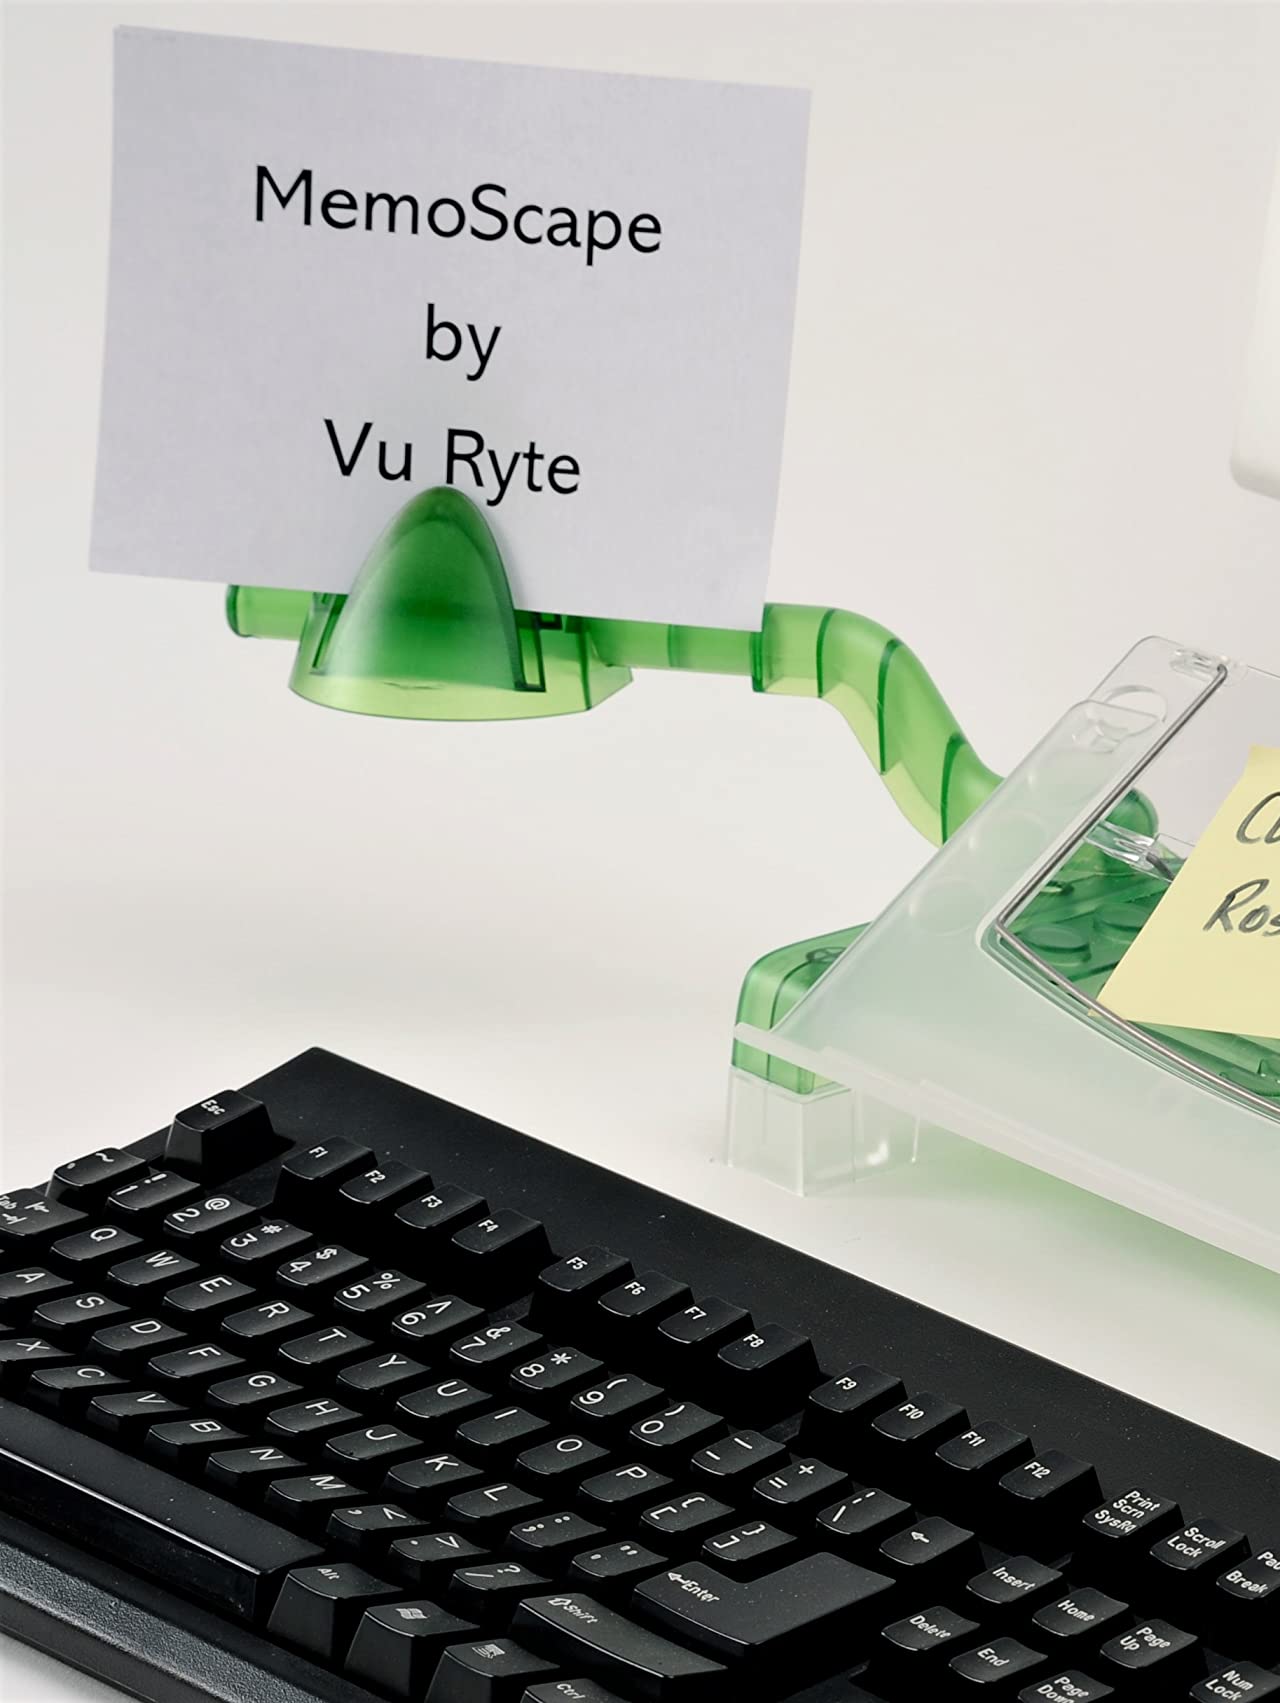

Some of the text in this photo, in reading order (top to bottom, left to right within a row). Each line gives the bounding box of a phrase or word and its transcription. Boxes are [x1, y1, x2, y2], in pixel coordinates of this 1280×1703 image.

[253, 164, 664, 267] MemoScape
[423, 302, 503, 382] by
[322, 417, 582, 507] Vu Ryte
[200, 1099, 225, 1115] Esc
[92, 1148, 114, 1163] ~
[309, 1146, 329, 1158] F1
[144, 1173, 167, 1184] !
[364, 1169, 386, 1184] F2
[116, 1185, 139, 1196] 1
[204, 1197, 231, 1211] @
[421, 1195, 443, 1208] F3
[172, 1208, 201, 1222] 2
[260, 1224, 283, 1234] #
[478, 1219, 499, 1233] F4
[90, 1228, 118, 1242] Q
[230, 1233, 258, 1248] 3
[145, 1251, 180, 1268] W
[315, 1248, 338, 1260] $
[289, 1261, 312, 1273] 4
[566, 1256, 588, 1270] F5
[15, 1272, 46, 1284] A
[199, 1276, 233, 1293] E
[372, 1272, 401, 1290] %
[342, 1284, 371, 1299] 5
[624, 1281, 646, 1295] F6
[75, 1296, 105, 1309] S
[258, 1302, 290, 1319] R
[684, 1306, 707, 1320] F7
[401, 1311, 427, 1325] 6
[130, 1320, 162, 1334] D
[486, 1326, 512, 1340] &
[318, 1328, 347, 1342] T
[743, 1333, 765, 1348] F8
[16, 1341, 50, 1352] X
[461, 1336, 487, 1350] 7
[188, 1346, 221, 1357] F
[378, 1354, 407, 1368] Y
[77, 1367, 105, 1379] C
[519, 1363, 545, 1378] 8
[248, 1374, 276, 1387] G
[606, 1378, 628, 1390] (
[835, 1377, 857, 1390] F9
[437, 1381, 468, 1397] U
[136, 1393, 166, 1403] V
[579, 1390, 605, 1405] 9
[305, 1400, 339, 1416] H
[494, 1409, 518, 1420] I
[664, 1404, 685, 1417] )
[898, 1403, 924, 1420] F10
[189, 1421, 222, 1433] B
[365, 1429, 397, 1441] J
[961, 1431, 986, 1447] F11
[556, 1438, 583, 1452] O
[249, 1448, 284, 1461] N
[424, 1455, 459, 1472] K
[798, 1465, 815, 1475] +
[1024, 1461, 1051, 1479] F12
[615, 1466, 648, 1479] P
[309, 1475, 346, 1490] M
[768, 1476, 788, 1489] =
[483, 1485, 508, 1502] L
[681, 1496, 706, 1509] {
[1112, 1498, 1145, 1519] Scrn
[1125, 1490, 1161, 1513] Print
[382, 1507, 407, 1520] <
[650, 1506, 678, 1520] [
[1094, 1508, 1138, 1533] SysRq
[741, 1524, 766, 1536] }
[435, 1535, 460, 1549] >
[712, 1535, 741, 1549] ]
[1184, 1526, 1227, 1550] Scroll
[1166, 1536, 1204, 1558] Lock
[317, 1568, 340, 1580] Alt
[497, 1564, 521, 1574] ?
[992, 1566, 1036, 1591] Insert
[1225, 1570, 1269, 1594] Break
[680, 1579, 720, 1602] Enter
[566, 1603, 598, 1624] Shift
[1057, 1600, 1095, 1621] Home
[909, 1615, 951, 1638] Delete
[1119, 1635, 1140, 1651] Up
[1136, 1627, 1171, 1648] Page
[977, 1647, 1010, 1667] End
[1054, 1676, 1089, 1697] Page
[1222, 1670, 1254, 1691] Num
[556, 1683, 586, 1699] Ctrl
[1037, 1684, 1076, 1703] Down
[1205, 1678, 1243, 1702] Lock
